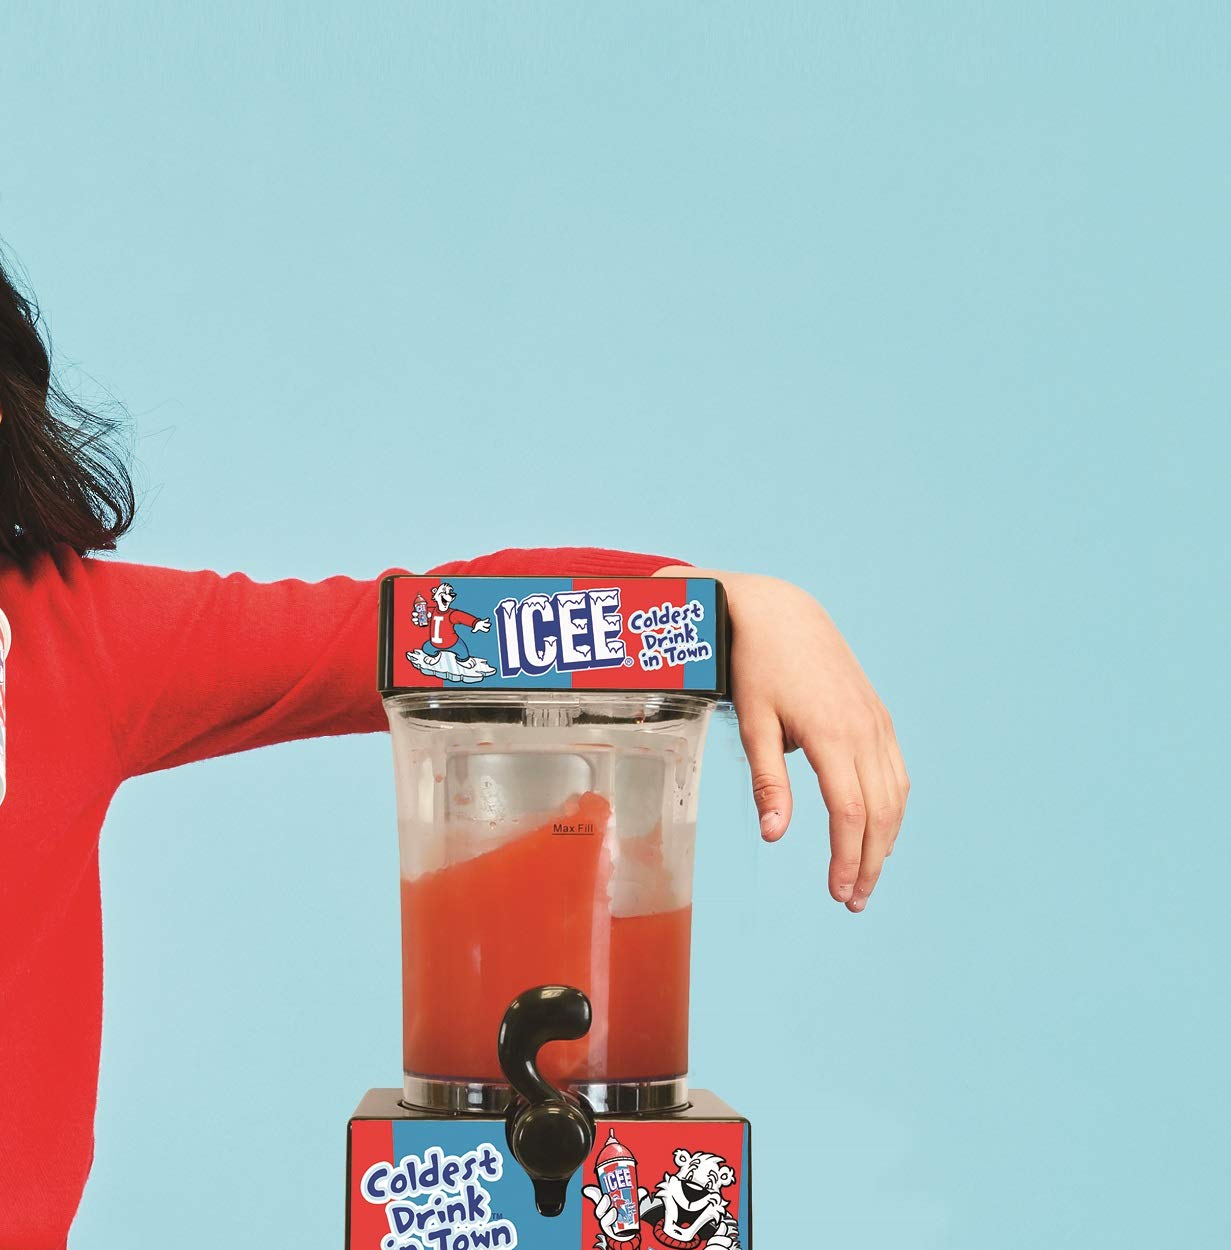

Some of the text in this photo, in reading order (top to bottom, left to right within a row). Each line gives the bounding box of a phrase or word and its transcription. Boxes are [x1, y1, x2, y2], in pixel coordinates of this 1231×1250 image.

[631, 604, 701, 630] Coldest
[495, 588, 625, 677] ICEE
[644, 623, 695, 650] Drink
[641, 645, 709, 667] in Town
[553, 823, 594, 833] Max Fill
[366, 1149, 497, 1198] Coldest
[603, 1169, 632, 1194] ICEE
[392, 1185, 485, 1234] Drink
